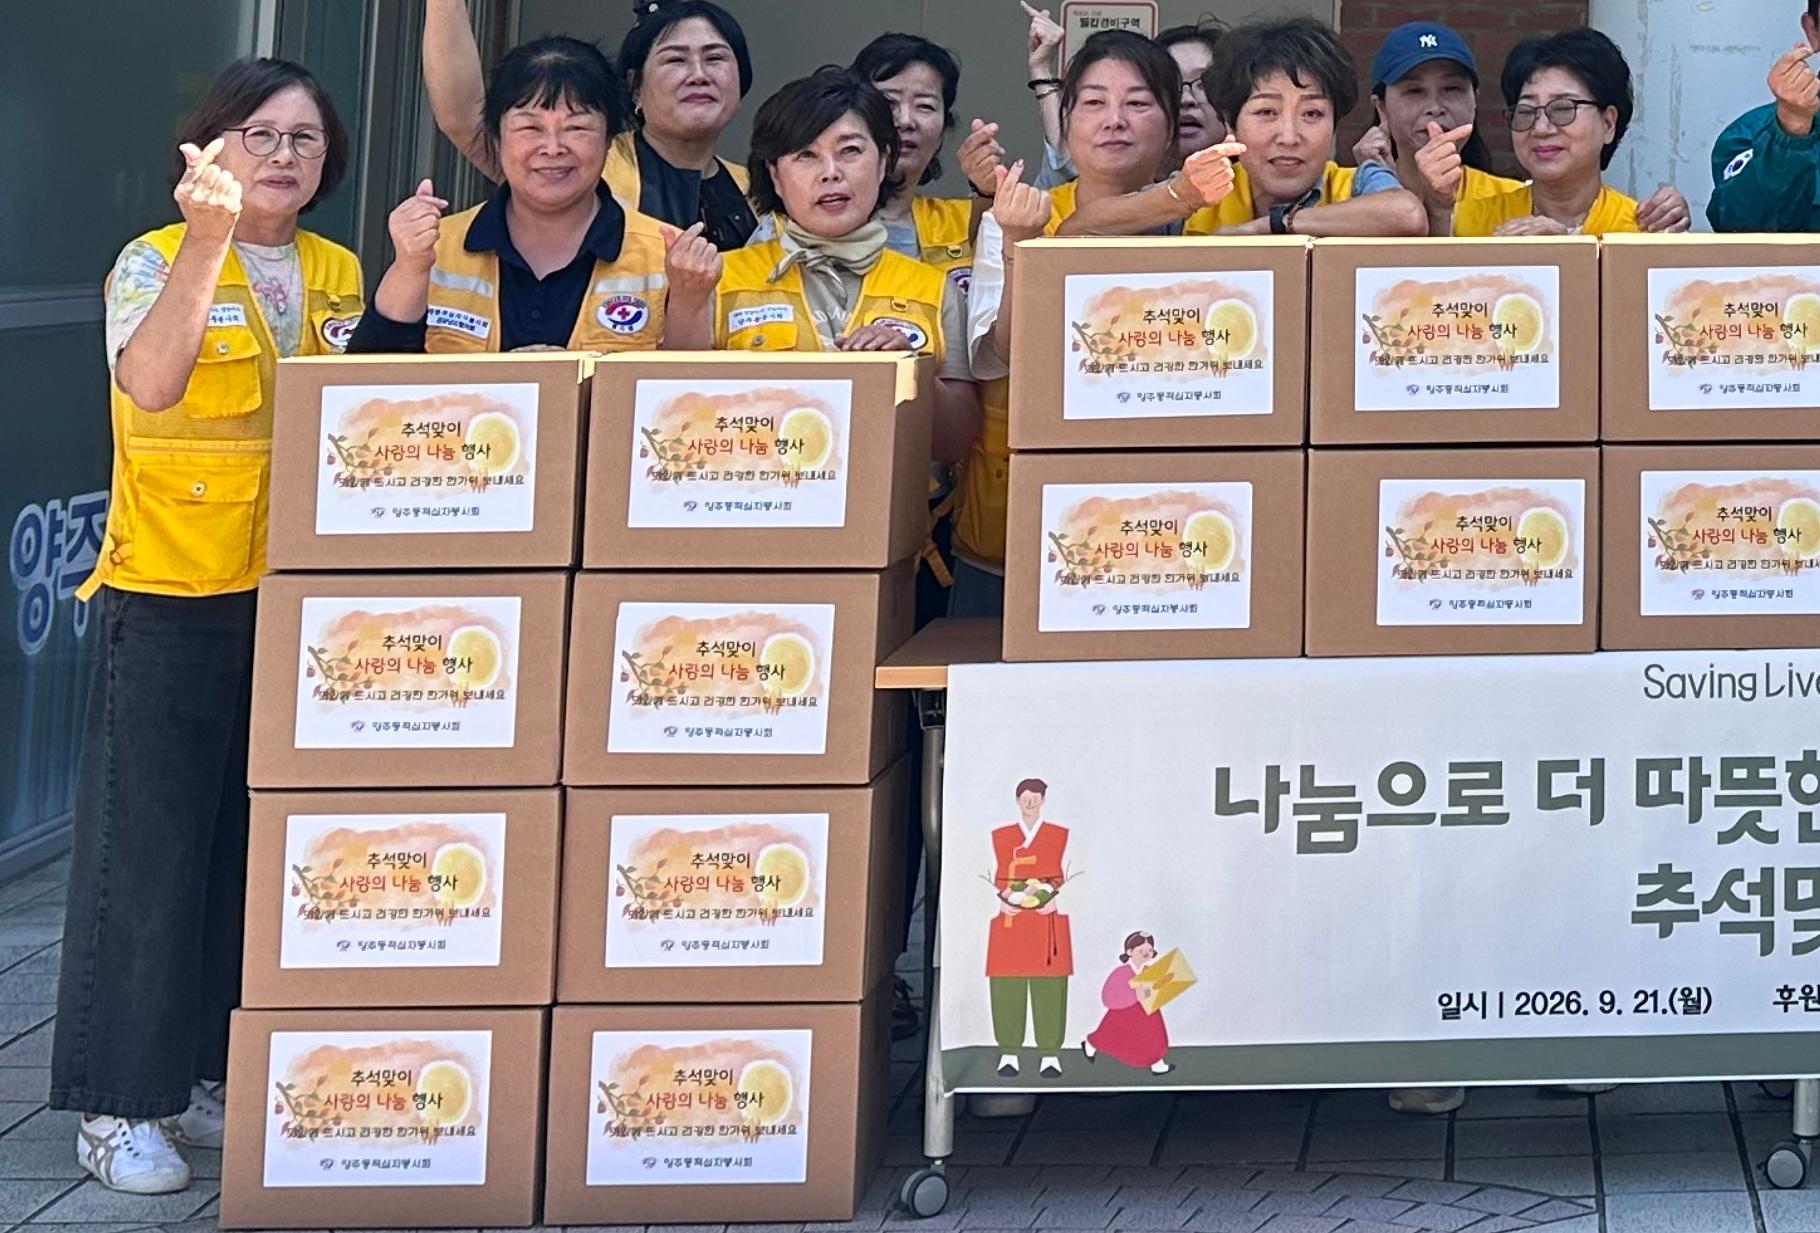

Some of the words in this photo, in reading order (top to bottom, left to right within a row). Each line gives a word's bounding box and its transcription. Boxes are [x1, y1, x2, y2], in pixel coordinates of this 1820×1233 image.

[1142, 308, 1200, 324] 추석맞이
[1431, 302, 1487, 318] 추석맞이
[1721, 302, 1777, 318] 추석맞이
[1118, 330, 1162, 346] 사랑의
[1168, 330, 1196, 345] 나눔
[1201, 328, 1230, 344] 행사
[1407, 324, 1450, 340] 사랑의
[1455, 324, 1483, 339] 나눔
[1487, 323, 1516, 338] 행사
[1699, 324, 1740, 340] 사랑의
[1746, 324, 1773, 339] 나눔
[1778, 323, 1806, 338] 행사
[402, 421, 462, 438] 추석맞이
[713, 417, 774, 433] 추석맞이
[376, 444, 422, 461] 사랑의
[427, 444, 457, 460] 나눔
[461, 443, 492, 459] 행사
[687, 439, 733, 456] 사랑의
[738, 440, 768, 455] 나눔
[772, 439, 804, 455] 행사
[1455, 514, 1512, 531] 추석맞이
[1716, 506, 1772, 522] 추석맞이
[1121, 520, 1179, 536] 추석맞이
[1692, 528, 1735, 544] 사랑의
[1740, 528, 1768, 544] 나눔
[1772, 527, 1801, 543] 행사
[1096, 542, 1140, 558] 사랑의
[1145, 543, 1174, 558] 나눔
[1178, 542, 1208, 557] 행사
[1431, 536, 1475, 553] 사랑의
[1480, 537, 1508, 552] 나눔
[1512, 536, 1542, 551] 행사
[381, 635, 442, 652] 추석맞이
[695, 640, 755, 657] 추석맞이
[354, 657, 401, 674] 사랑의
[406, 658, 436, 674] 나눔
[440, 657, 472, 673] 행사
[669, 662, 715, 679] 사랑의
[720, 663, 750, 679] 나눔
[754, 662, 785, 678] 행사
[1643, 661, 1757, 703] Saving
[1214, 760, 1511, 855] 나눔으로
[1536, 757, 1606, 827] 더
[367, 852, 427, 869] 추석맞이
[691, 852, 751, 869] 추석맞이
[340, 875, 387, 892] 사랑의
[392, 876, 422, 892] 나눔
[426, 875, 458, 891] 행사
[665, 875, 711, 893] 사랑의
[716, 876, 746, 892] 나눔
[750, 874, 781, 891] 행사
[1437, 991, 1488, 1020] 일시
[1514, 990, 1589, 1016] 2026.
[1598, 989, 1623, 1016] 9.
[1632, 986, 1713, 1016] 21.(월)
[352, 1070, 414, 1087] 추석맞이
[672, 1070, 733, 1087] 추석맞이
[325, 1093, 373, 1110] 사랑의
[378, 1094, 408, 1110] 나눔
[413, 1092, 444, 1109] 행사
[646, 1093, 692, 1110] 사랑의
[698, 1093, 728, 1110] 나눔
[732, 1092, 764, 1109] 행사
